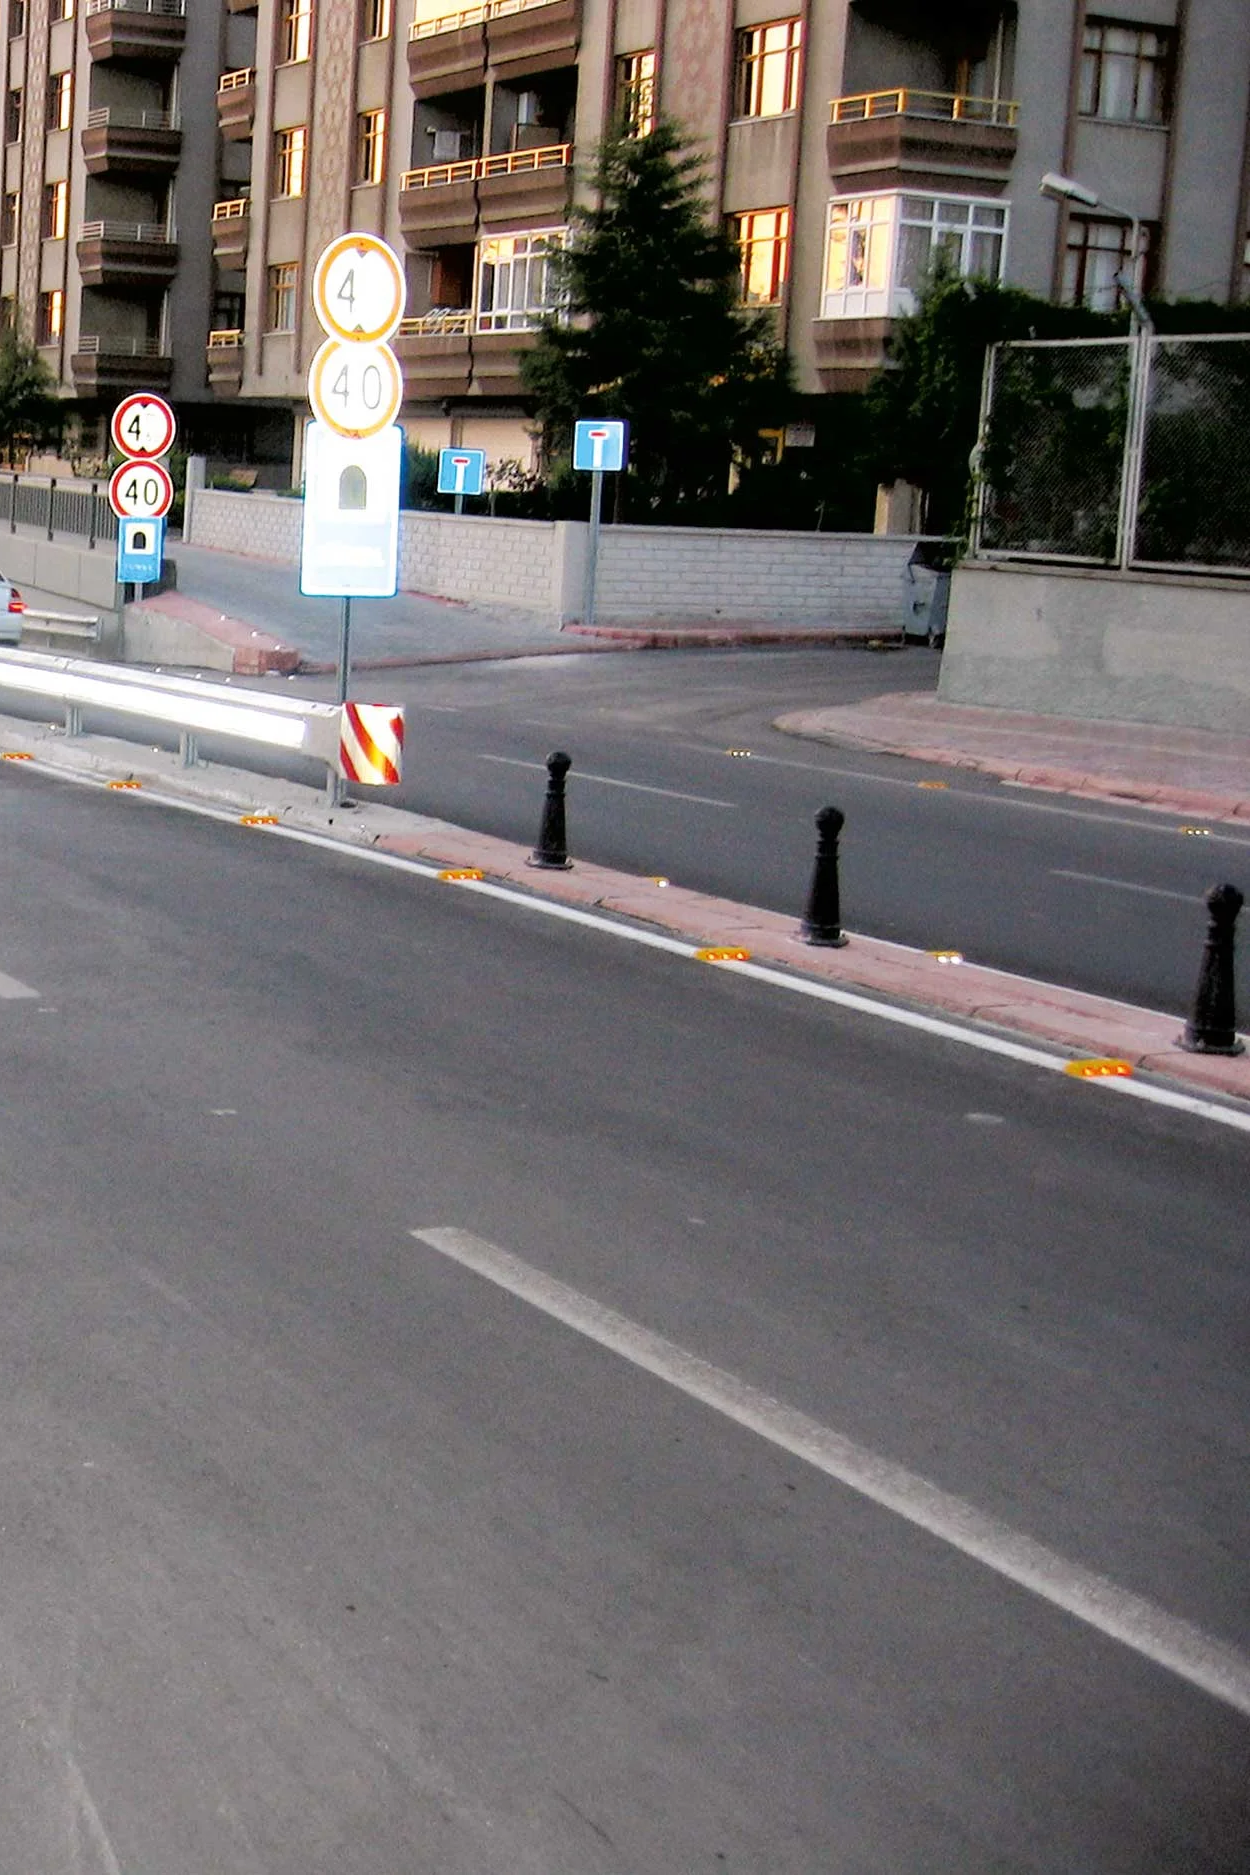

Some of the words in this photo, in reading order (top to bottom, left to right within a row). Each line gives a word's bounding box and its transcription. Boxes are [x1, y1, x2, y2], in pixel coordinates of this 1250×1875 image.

[337, 268, 355, 313] 4
[331, 364, 382, 410] 40
[127, 414, 141, 442] 4
[125, 478, 159, 506] 40
